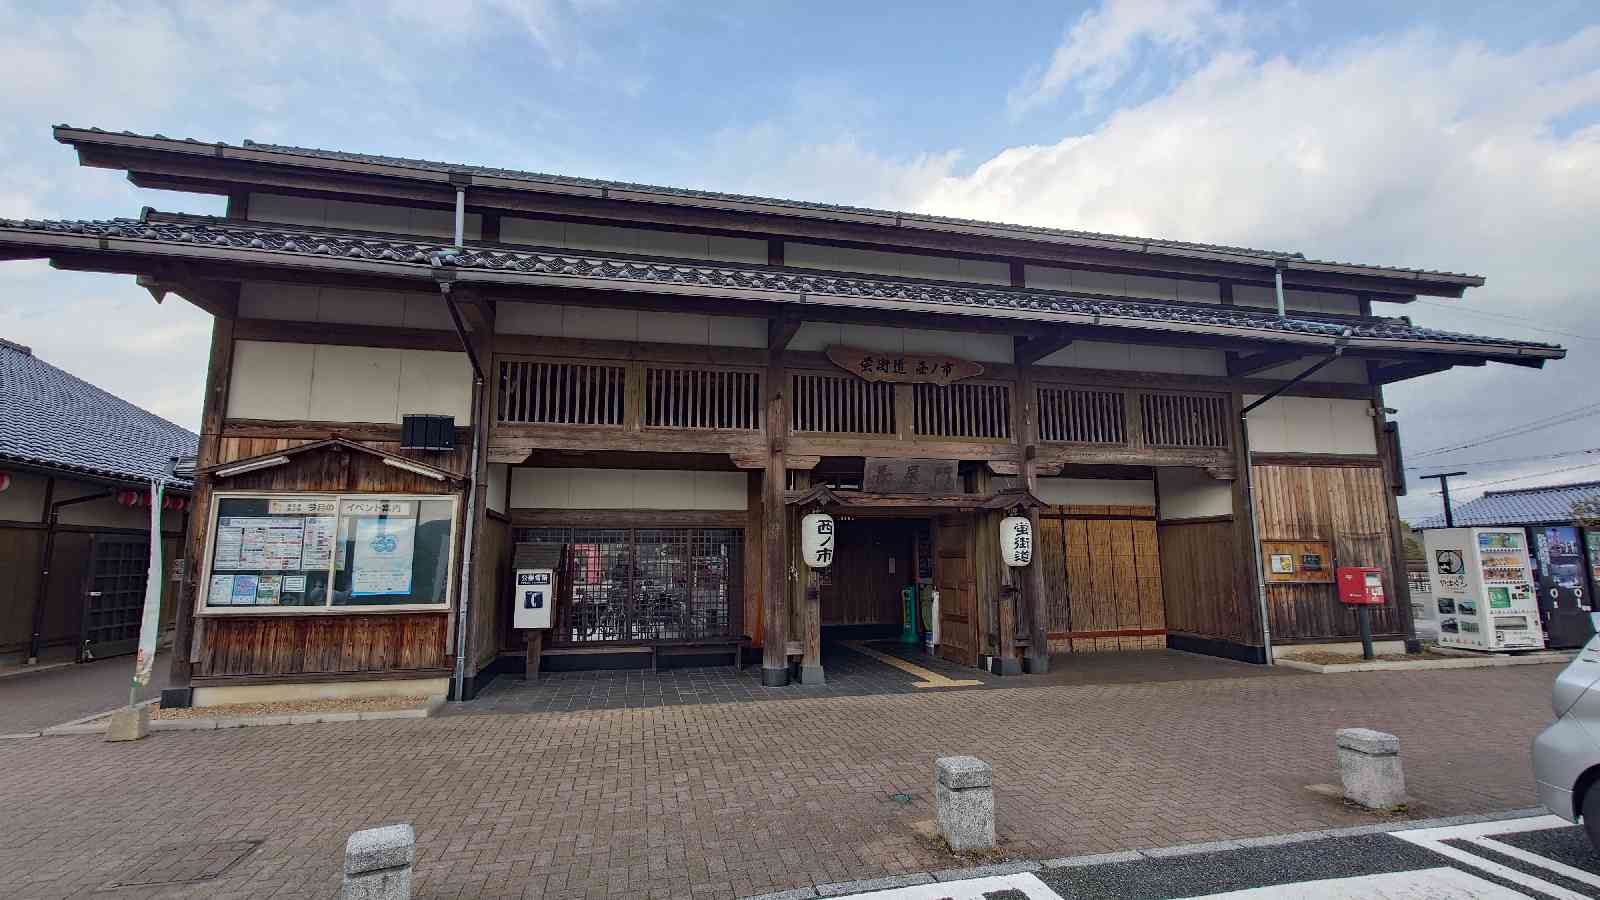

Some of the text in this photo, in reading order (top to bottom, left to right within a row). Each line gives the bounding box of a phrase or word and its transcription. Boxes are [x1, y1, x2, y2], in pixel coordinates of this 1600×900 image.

[815, 519, 833, 563] 西ノ市
[1013, 520, 1031, 562] 蛍街道
